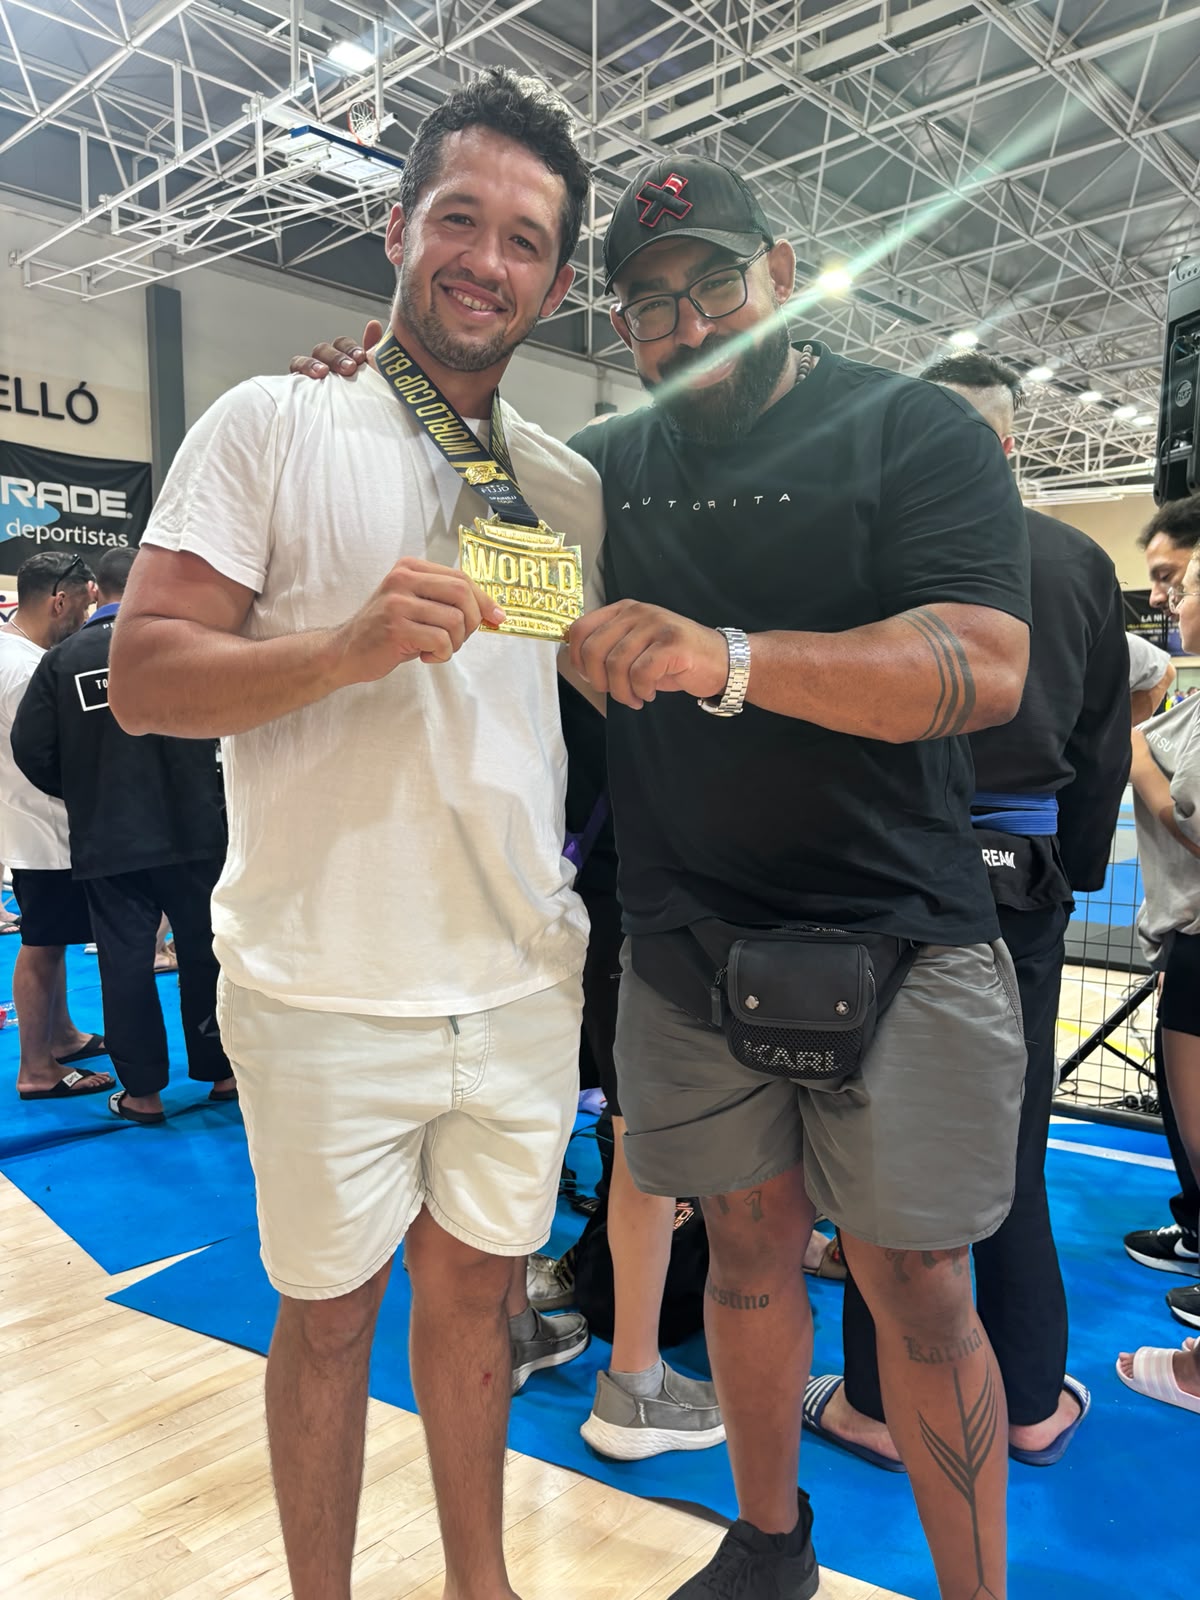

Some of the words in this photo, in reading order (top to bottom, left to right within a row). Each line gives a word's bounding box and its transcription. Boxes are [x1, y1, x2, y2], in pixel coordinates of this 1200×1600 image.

[378, 346, 412, 376] BJJ
[394, 374, 437, 404] CUP
[416, 402, 481, 456] WORLD
[6, 517, 129, 547] deportistas
[464, 541, 579, 595] WORLD
